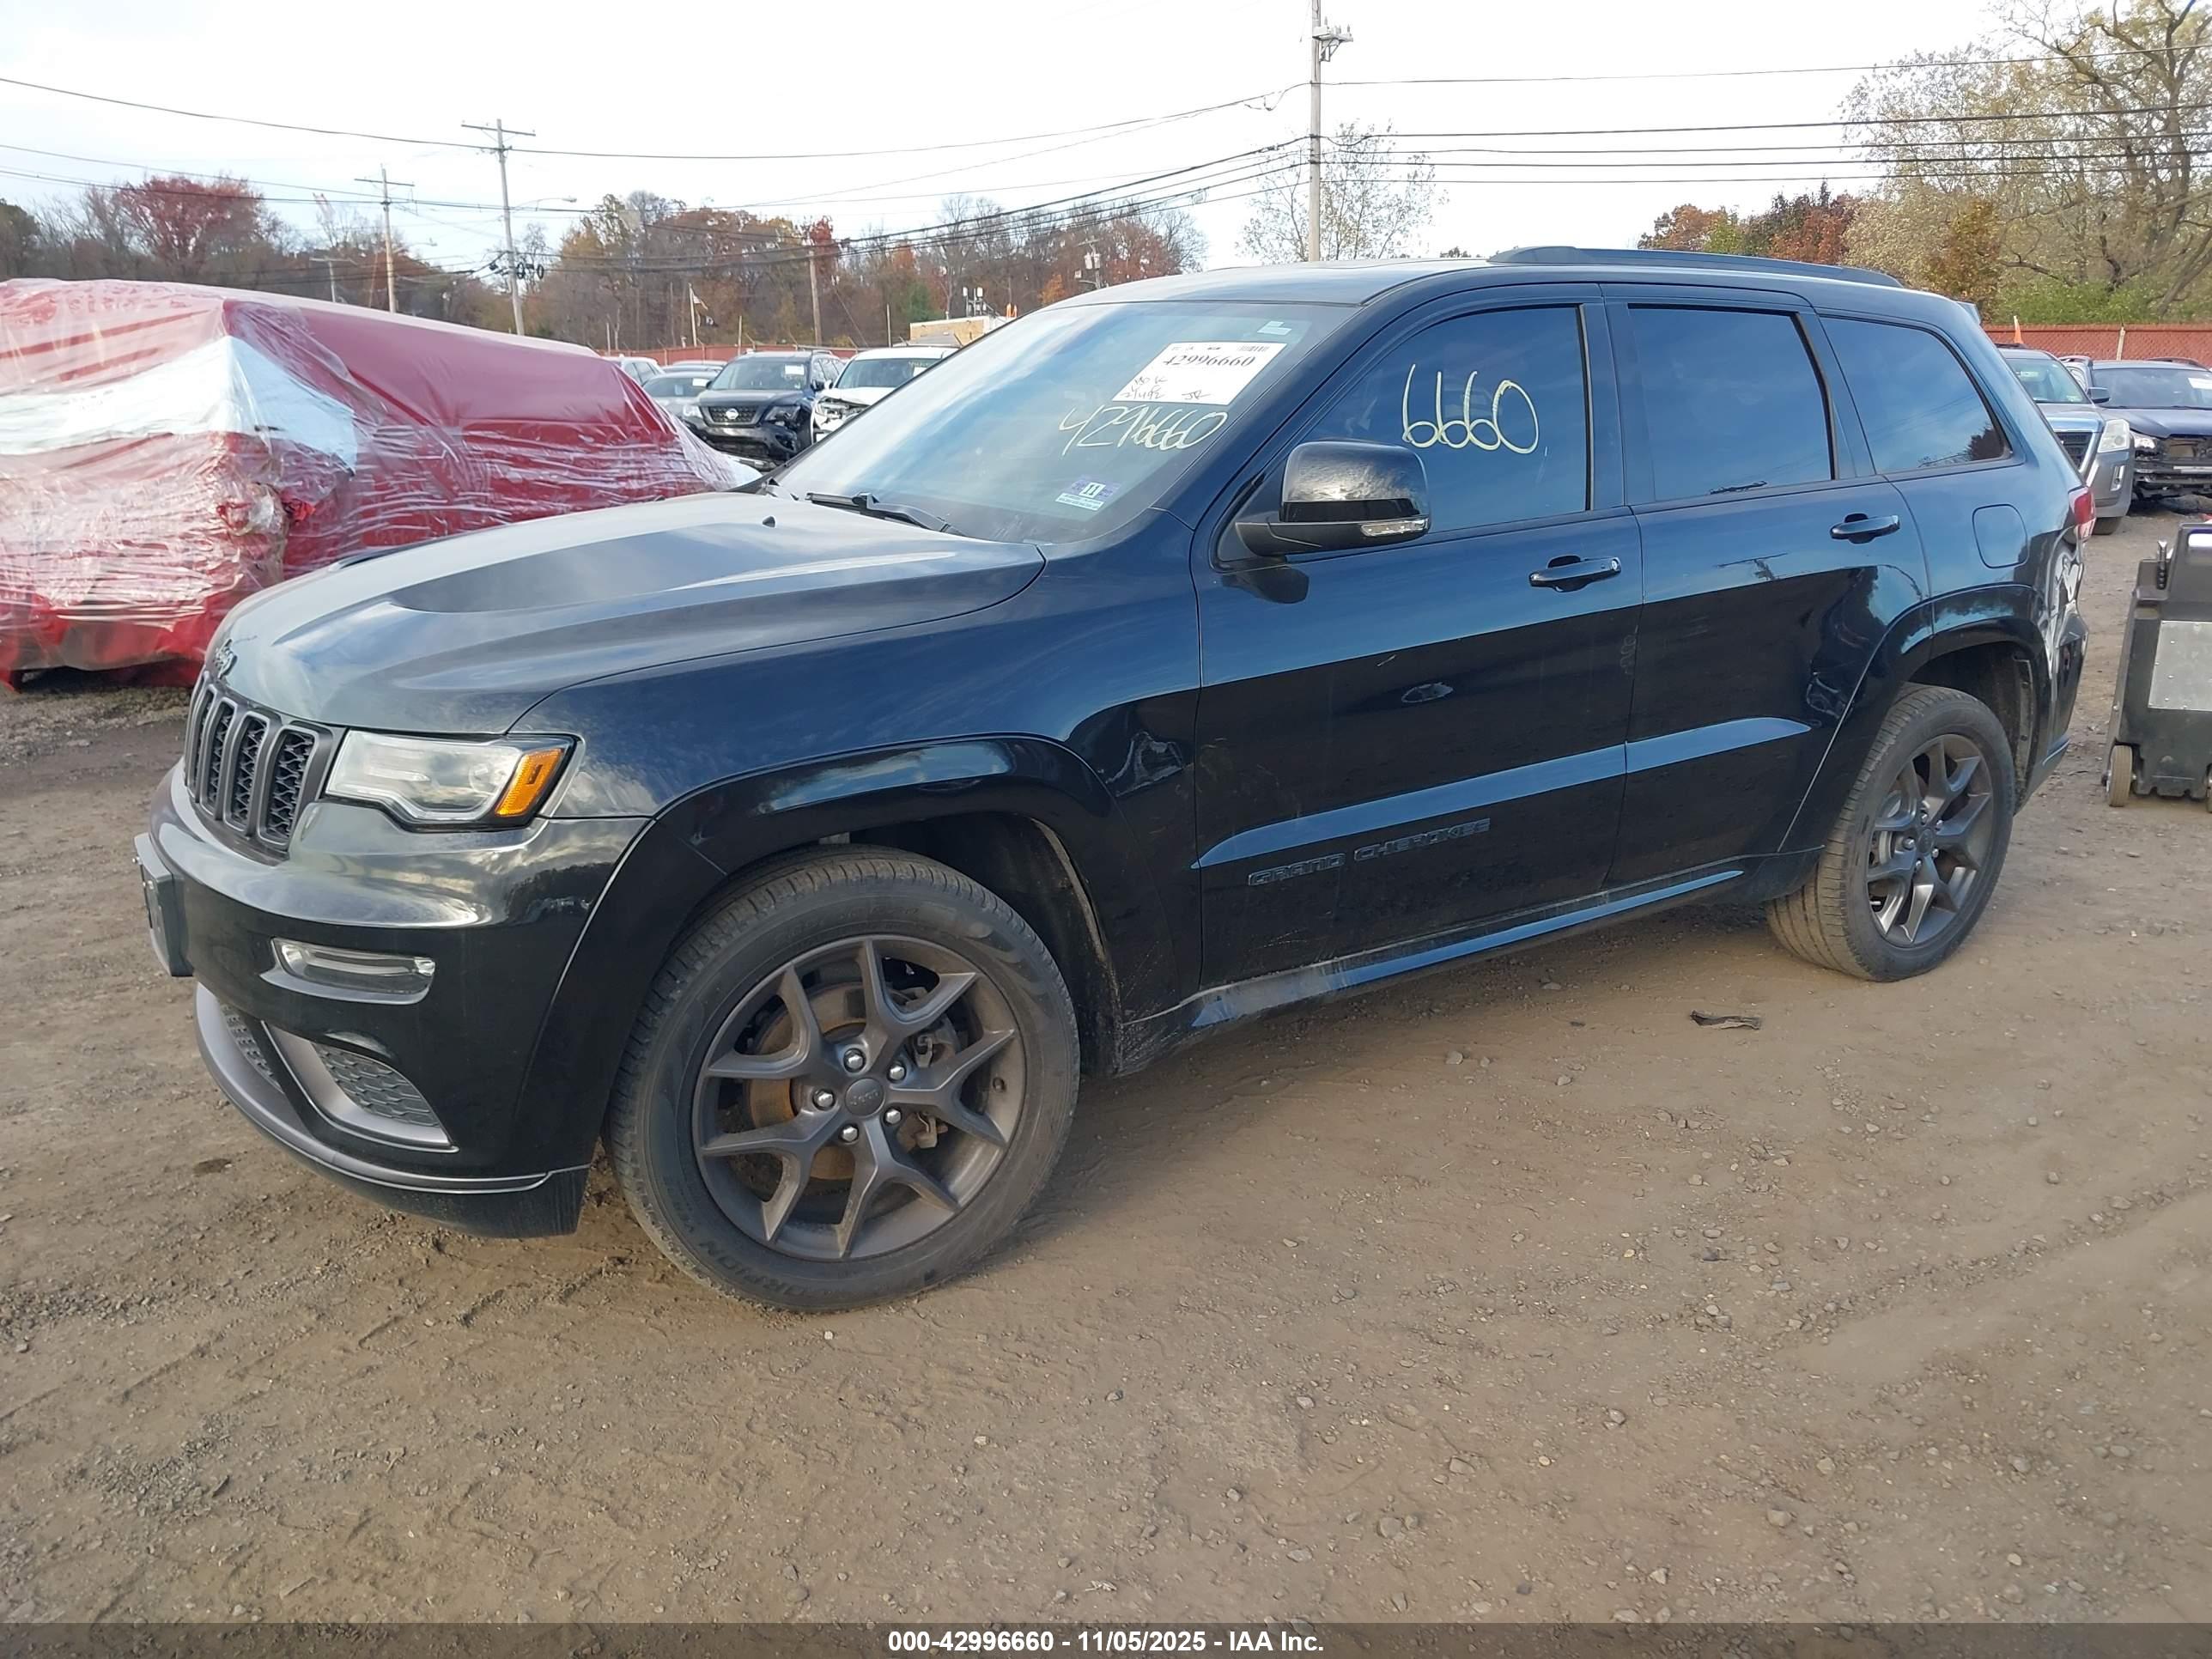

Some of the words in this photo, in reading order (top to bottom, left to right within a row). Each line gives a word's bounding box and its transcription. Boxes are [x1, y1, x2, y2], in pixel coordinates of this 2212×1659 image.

[1163, 355, 1256, 367] 42996660
[1401, 363, 1540, 454] 6660
[1249, 853, 1346, 886] GRAND
[1354, 817, 1492, 861] CHEROKEE
